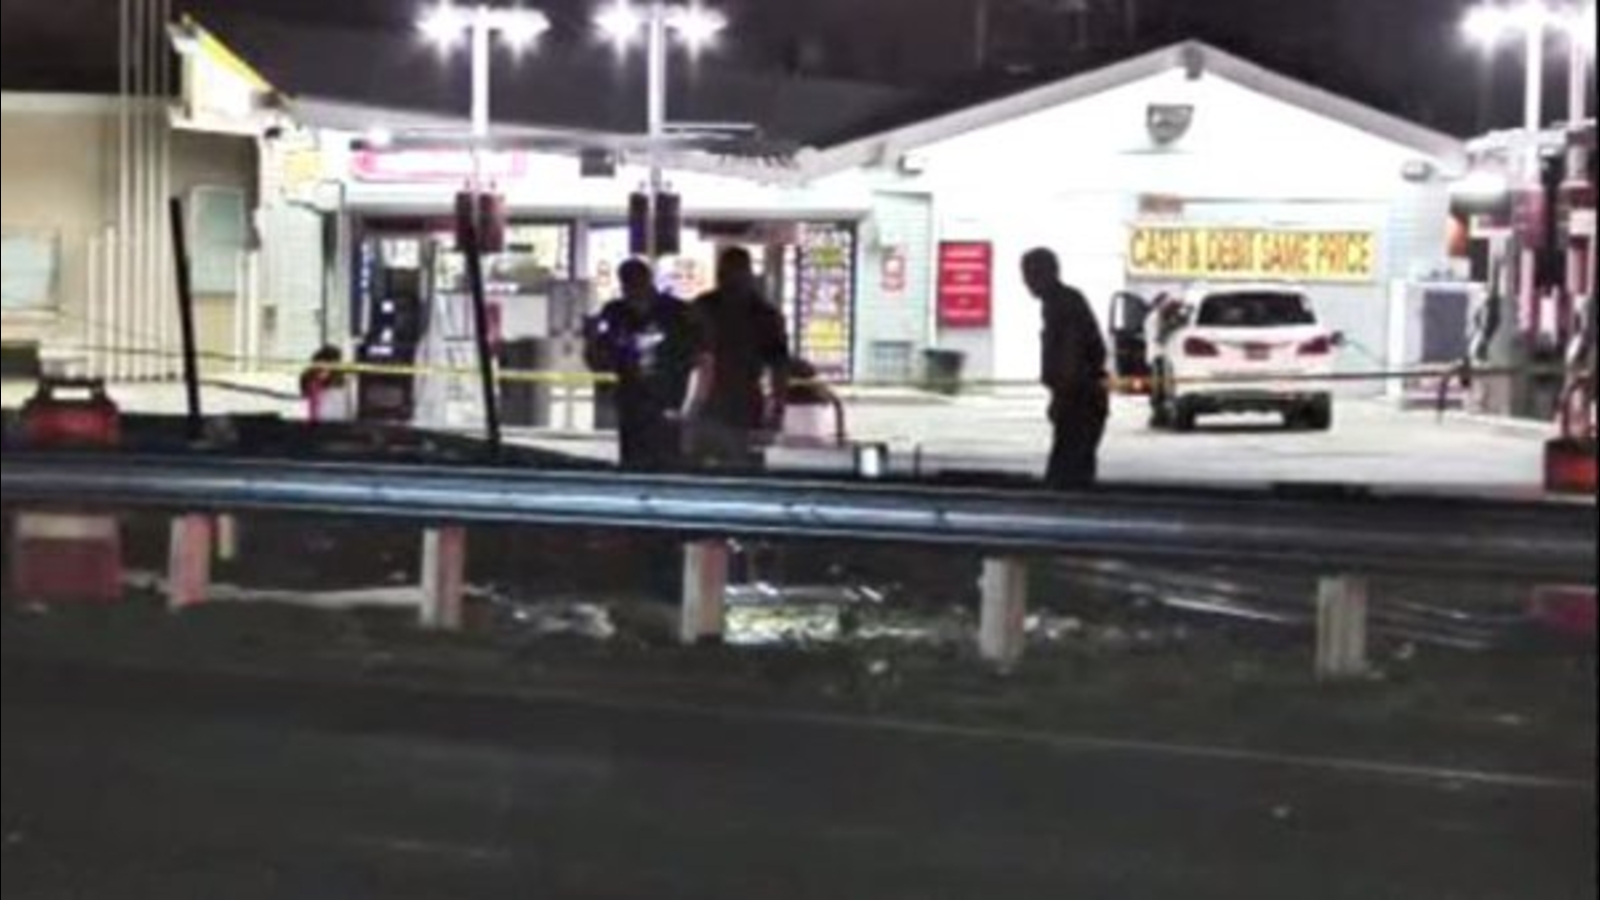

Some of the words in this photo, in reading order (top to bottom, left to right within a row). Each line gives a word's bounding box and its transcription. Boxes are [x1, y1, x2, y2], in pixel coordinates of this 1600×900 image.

[1131, 228, 1182, 271] CASH
[1206, 229, 1256, 273] DEBIT
[1260, 231, 1313, 273] SAME
[1316, 231, 1371, 275] PRICE
